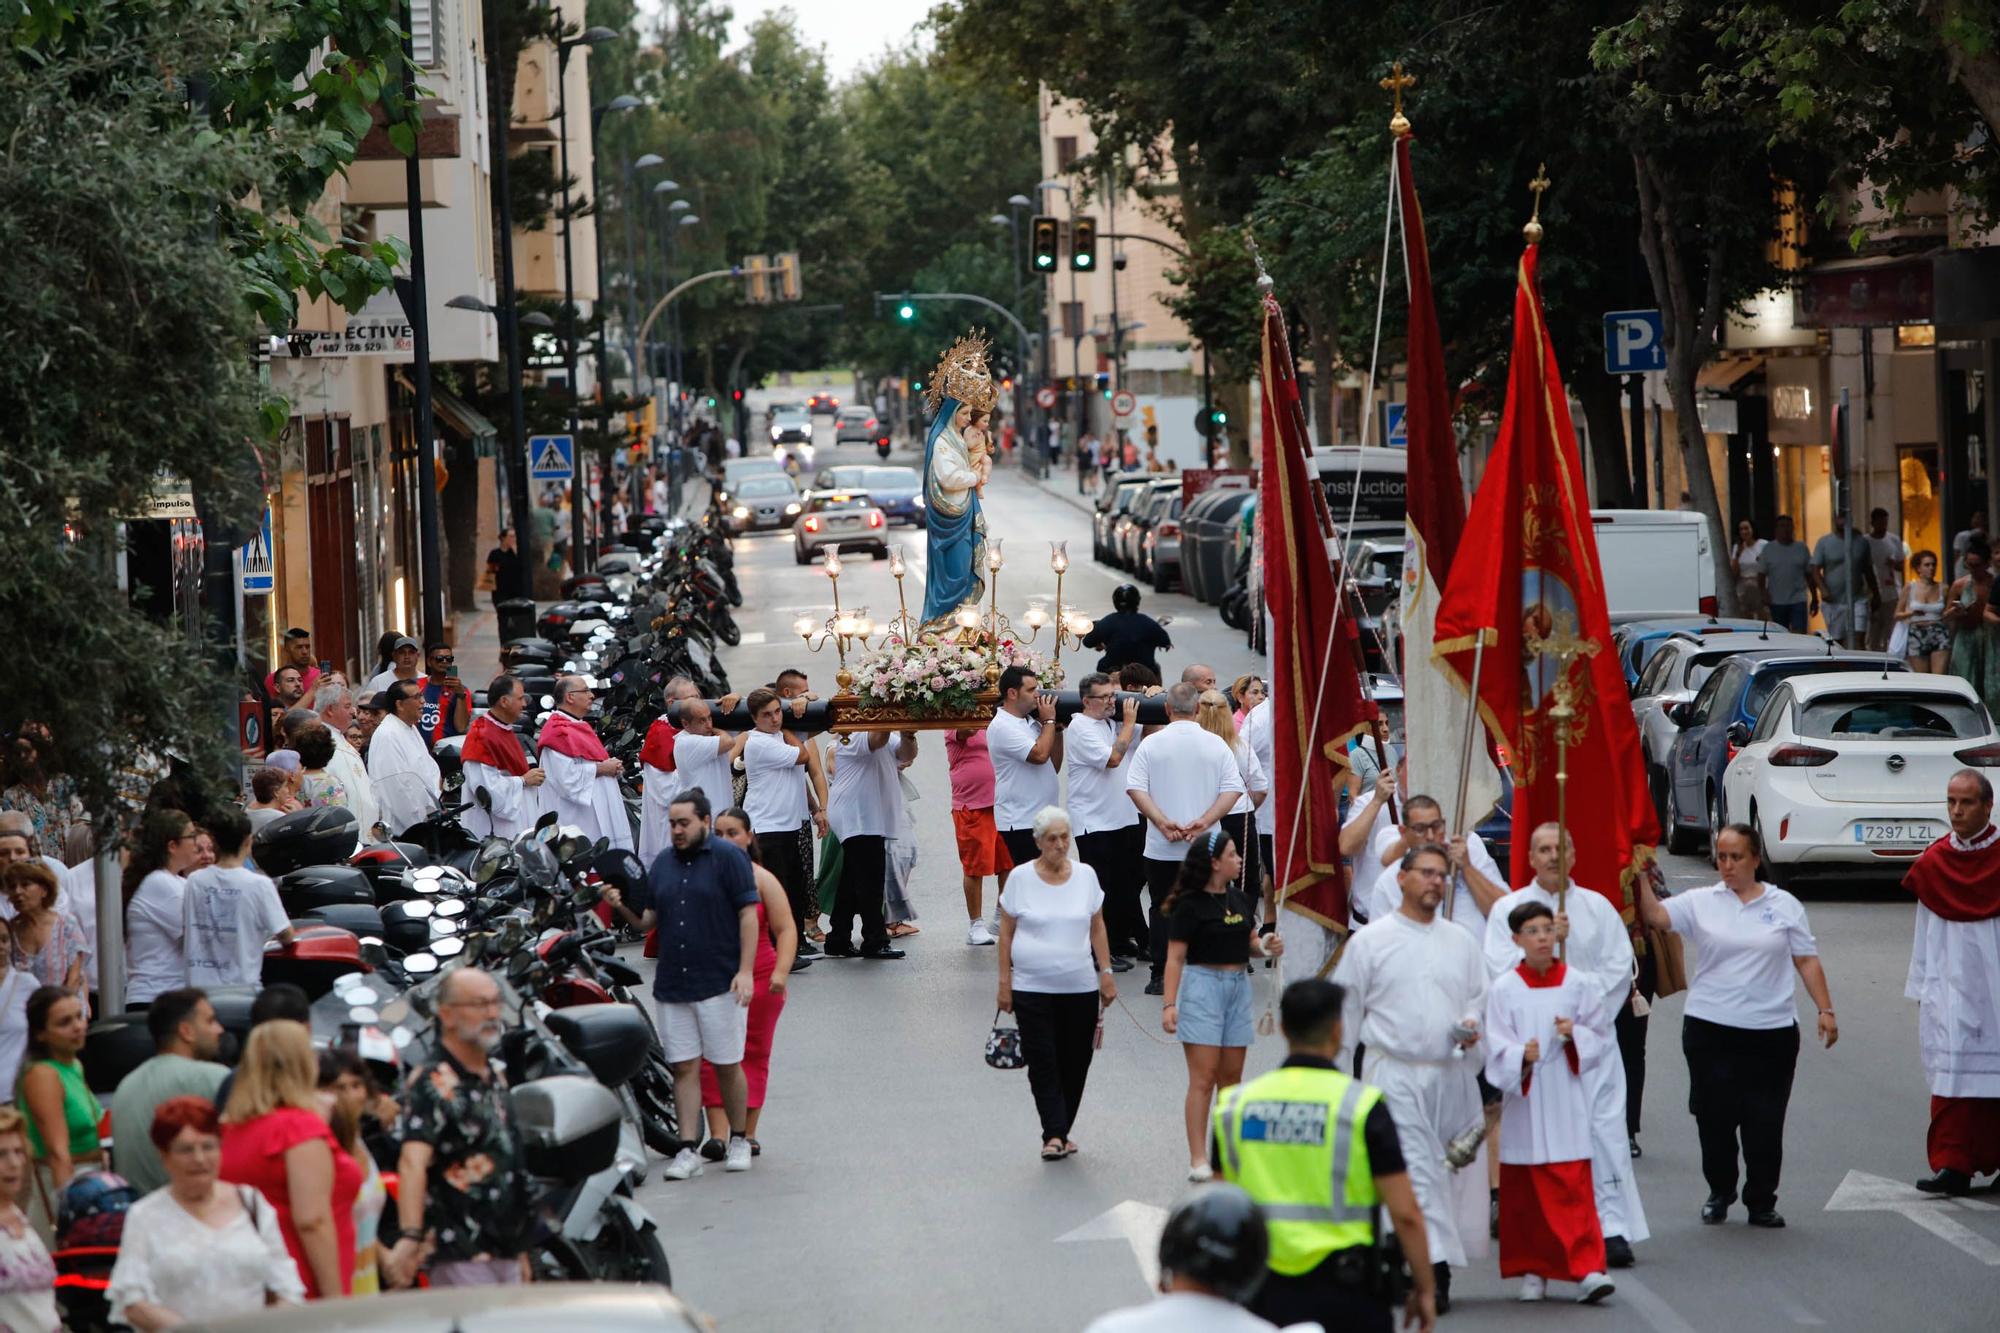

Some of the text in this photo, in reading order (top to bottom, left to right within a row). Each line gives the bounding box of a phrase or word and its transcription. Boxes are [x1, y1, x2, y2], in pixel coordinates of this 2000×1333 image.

[345, 343, 360, 351] 128
[1616, 319, 1654, 366] P
[1865, 826, 1936, 839] 7297 LZL
[1265, 1119, 1325, 1145] LOCAL
